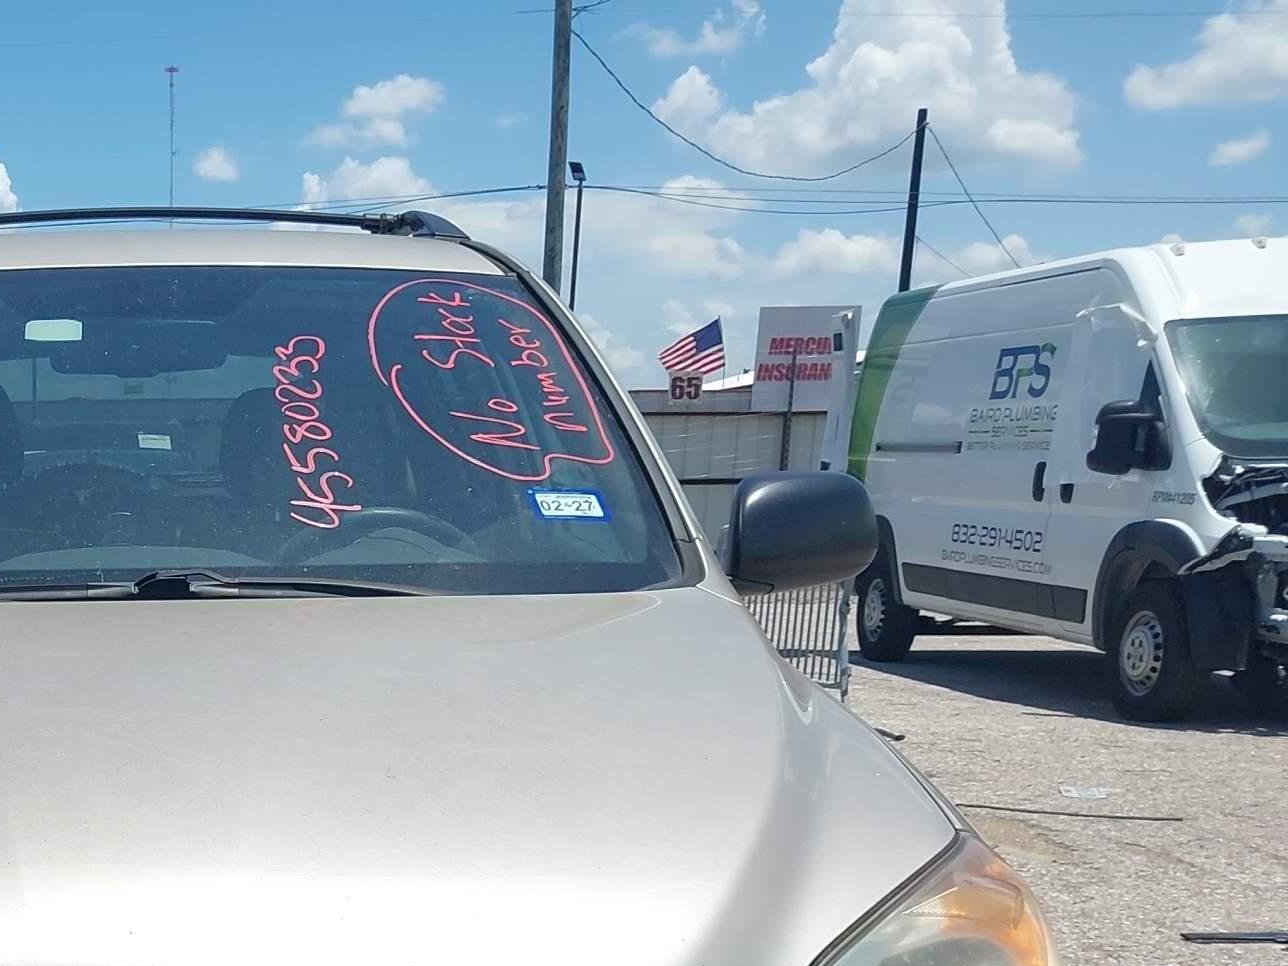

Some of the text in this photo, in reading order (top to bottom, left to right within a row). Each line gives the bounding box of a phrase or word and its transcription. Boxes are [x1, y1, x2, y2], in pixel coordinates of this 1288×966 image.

[768, 336, 831, 355] MERCU
[671, 376, 700, 400] 65
[989, 342, 1057, 400] BPS
[272, 336, 362, 528] 45580233
[449, 398, 541, 450] No
[951, 523, 1043, 553] 832-291-4502
